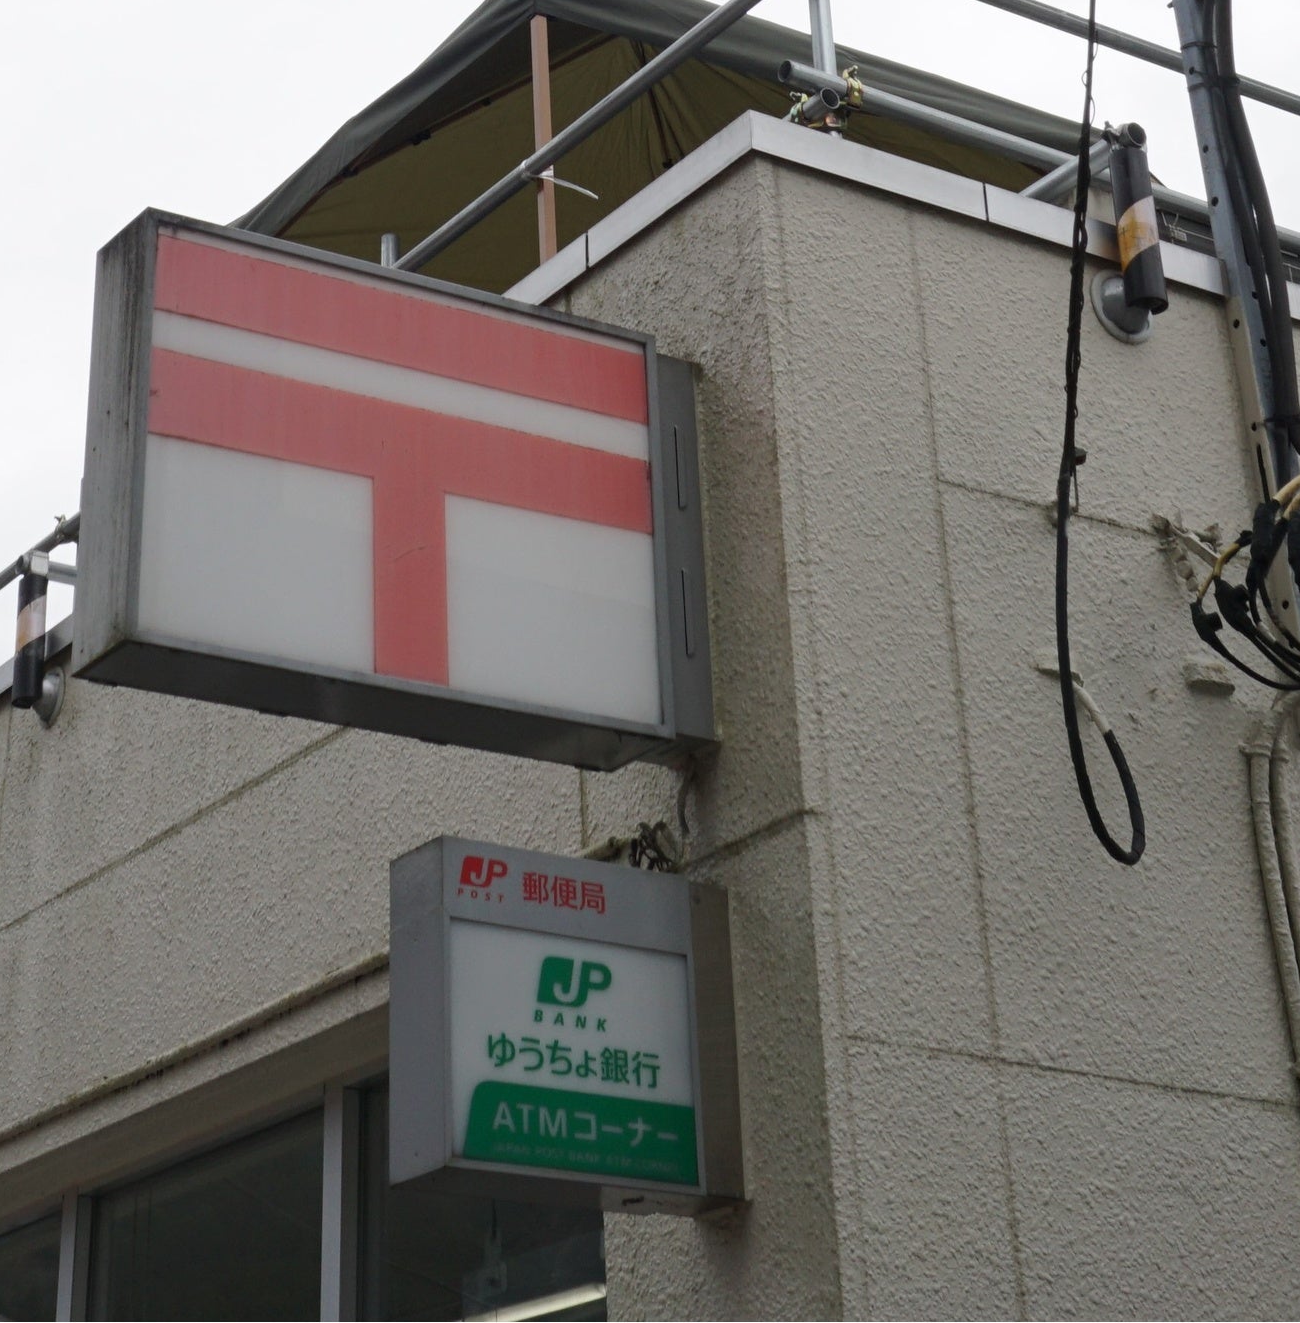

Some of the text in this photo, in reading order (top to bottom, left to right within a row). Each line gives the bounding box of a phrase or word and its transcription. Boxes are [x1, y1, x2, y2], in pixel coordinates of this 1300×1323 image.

[457, 888, 505, 903] POST
[522, 871, 607, 915] 郵便局
[537, 956, 612, 1007] JP
[533, 1009, 608, 1032] BANK
[487, 1032, 661, 1089] ゆうちょ銀行
[492, 1100, 679, 1148] ATMコーナー
